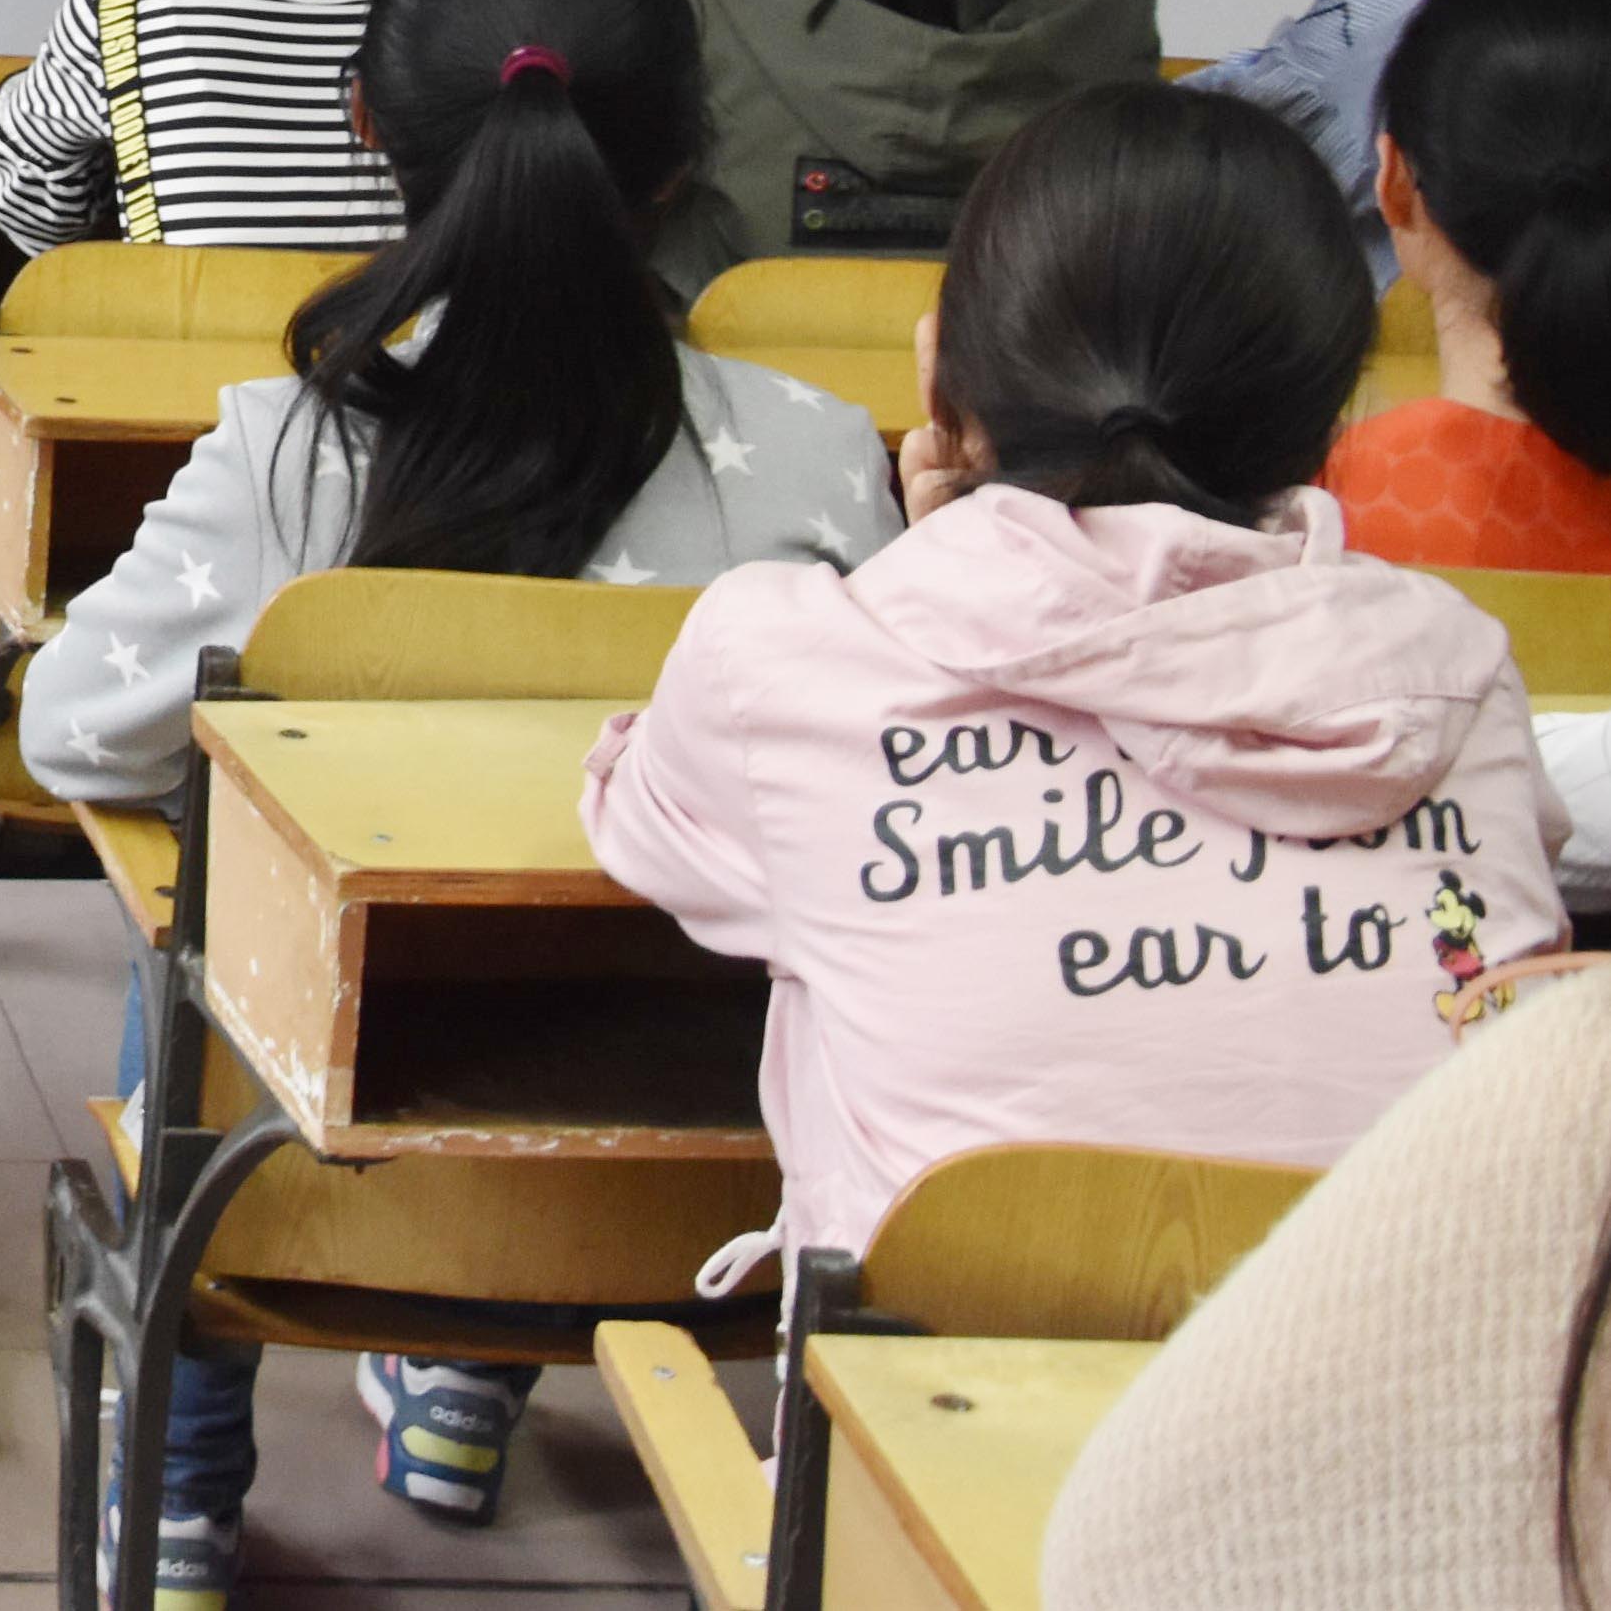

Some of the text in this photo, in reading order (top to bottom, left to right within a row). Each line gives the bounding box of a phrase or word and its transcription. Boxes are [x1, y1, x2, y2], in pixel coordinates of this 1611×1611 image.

[109, 89, 151, 184] LOONEY
[880, 718, 1077, 786] ear
[860, 768, 1204, 903] Smile
[1058, 885, 1408, 997] ear to
